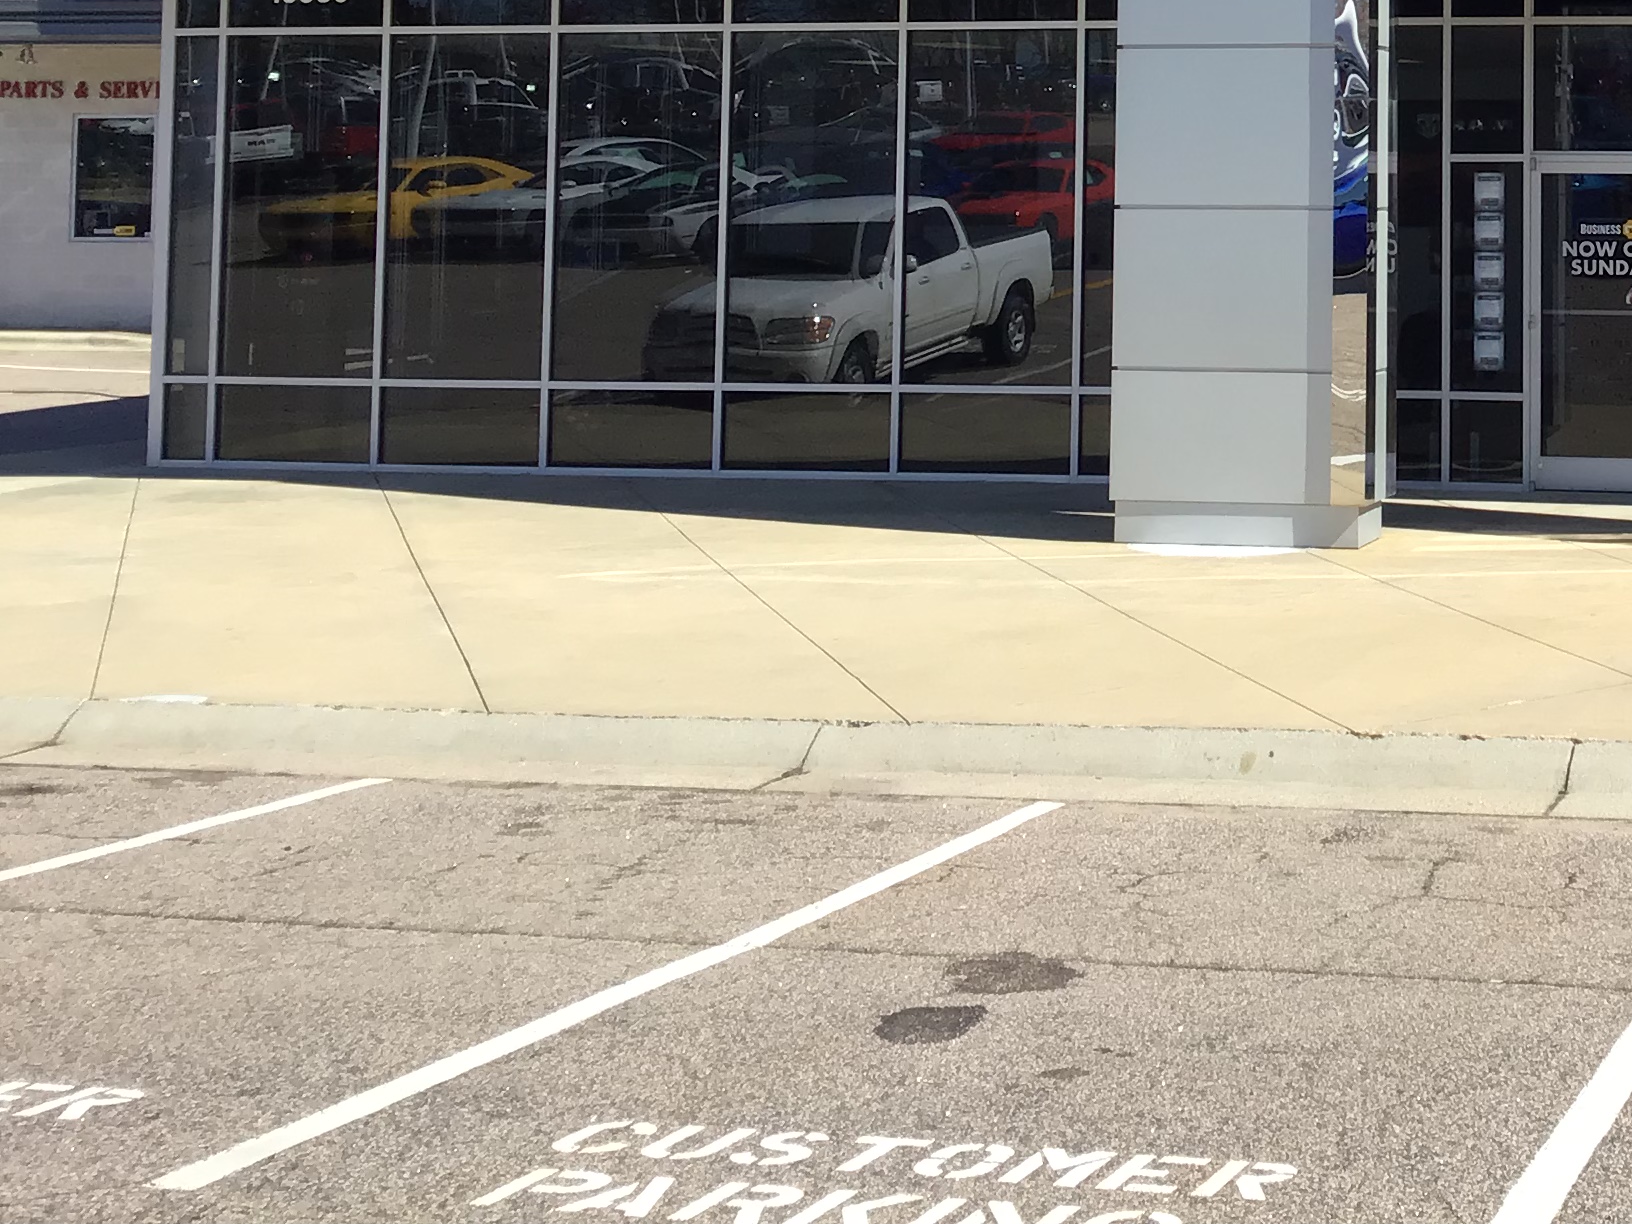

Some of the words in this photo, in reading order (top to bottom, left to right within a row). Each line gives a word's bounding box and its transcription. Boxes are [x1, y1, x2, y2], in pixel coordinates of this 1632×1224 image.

[0, 80, 65, 99] PARTS
[73, 80, 90, 99] &
[1580, 223, 1622, 235] BUSINESS
[1562, 240, 1617, 257] NOW
[551, 1121, 1299, 1201] CUSTOMER
